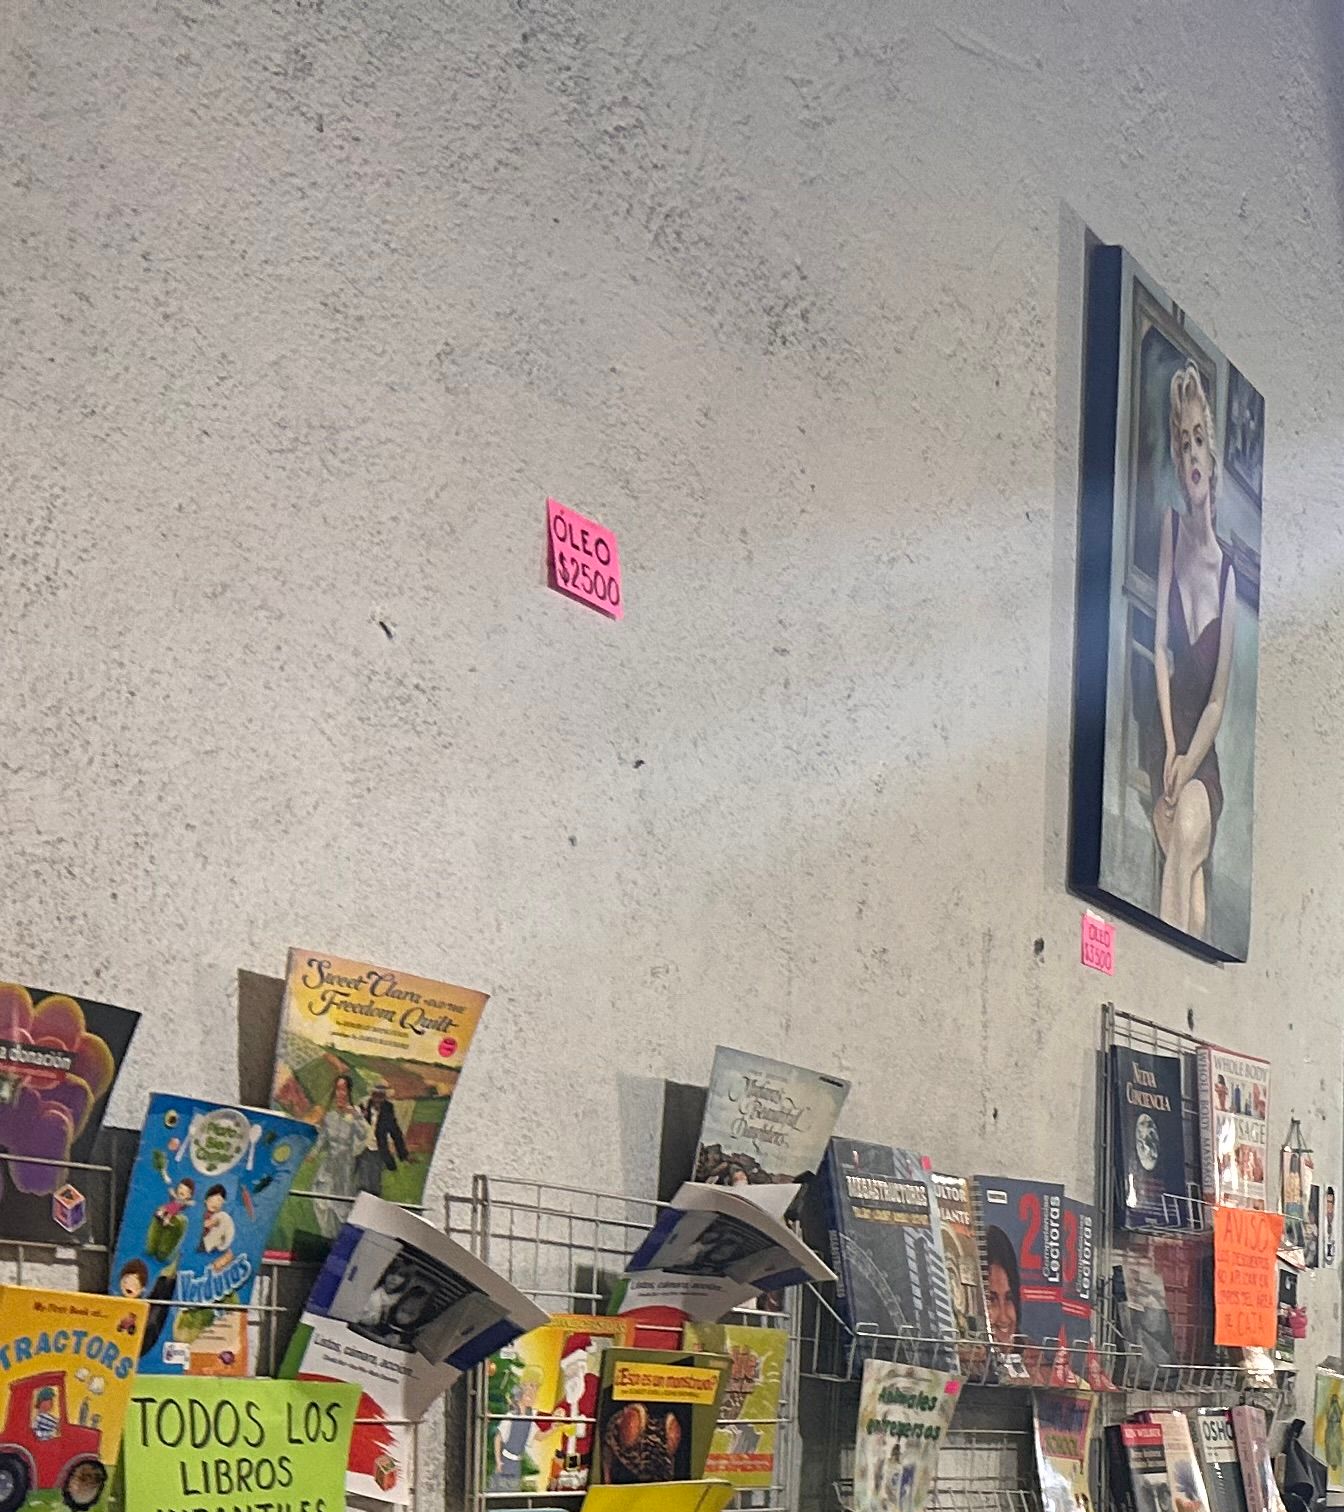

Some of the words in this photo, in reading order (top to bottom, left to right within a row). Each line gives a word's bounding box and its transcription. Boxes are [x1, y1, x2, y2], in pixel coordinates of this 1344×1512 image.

[559, 552, 620, 606] $2500
[303, 957, 368, 995] Sweet
[367, 969, 422, 1005] Clara
[308, 989, 396, 1023] Freedom
[400, 1008, 458, 1035] Quilt
[8, 1041, 72, 1071] donación
[1213, 1054, 1244, 1075] WHOLE
[1019, 1192, 1042, 1269] 2
[1048, 1195, 1061, 1283] Lectoras
[1080, 1216, 1093, 1300] Lectoras
[0, 1330, 135, 1379] TRACTORS
[131, 1396, 267, 1449] TODOS
[286, 1400, 342, 1445] LOS
[179, 1455, 294, 1497] LIBROS
